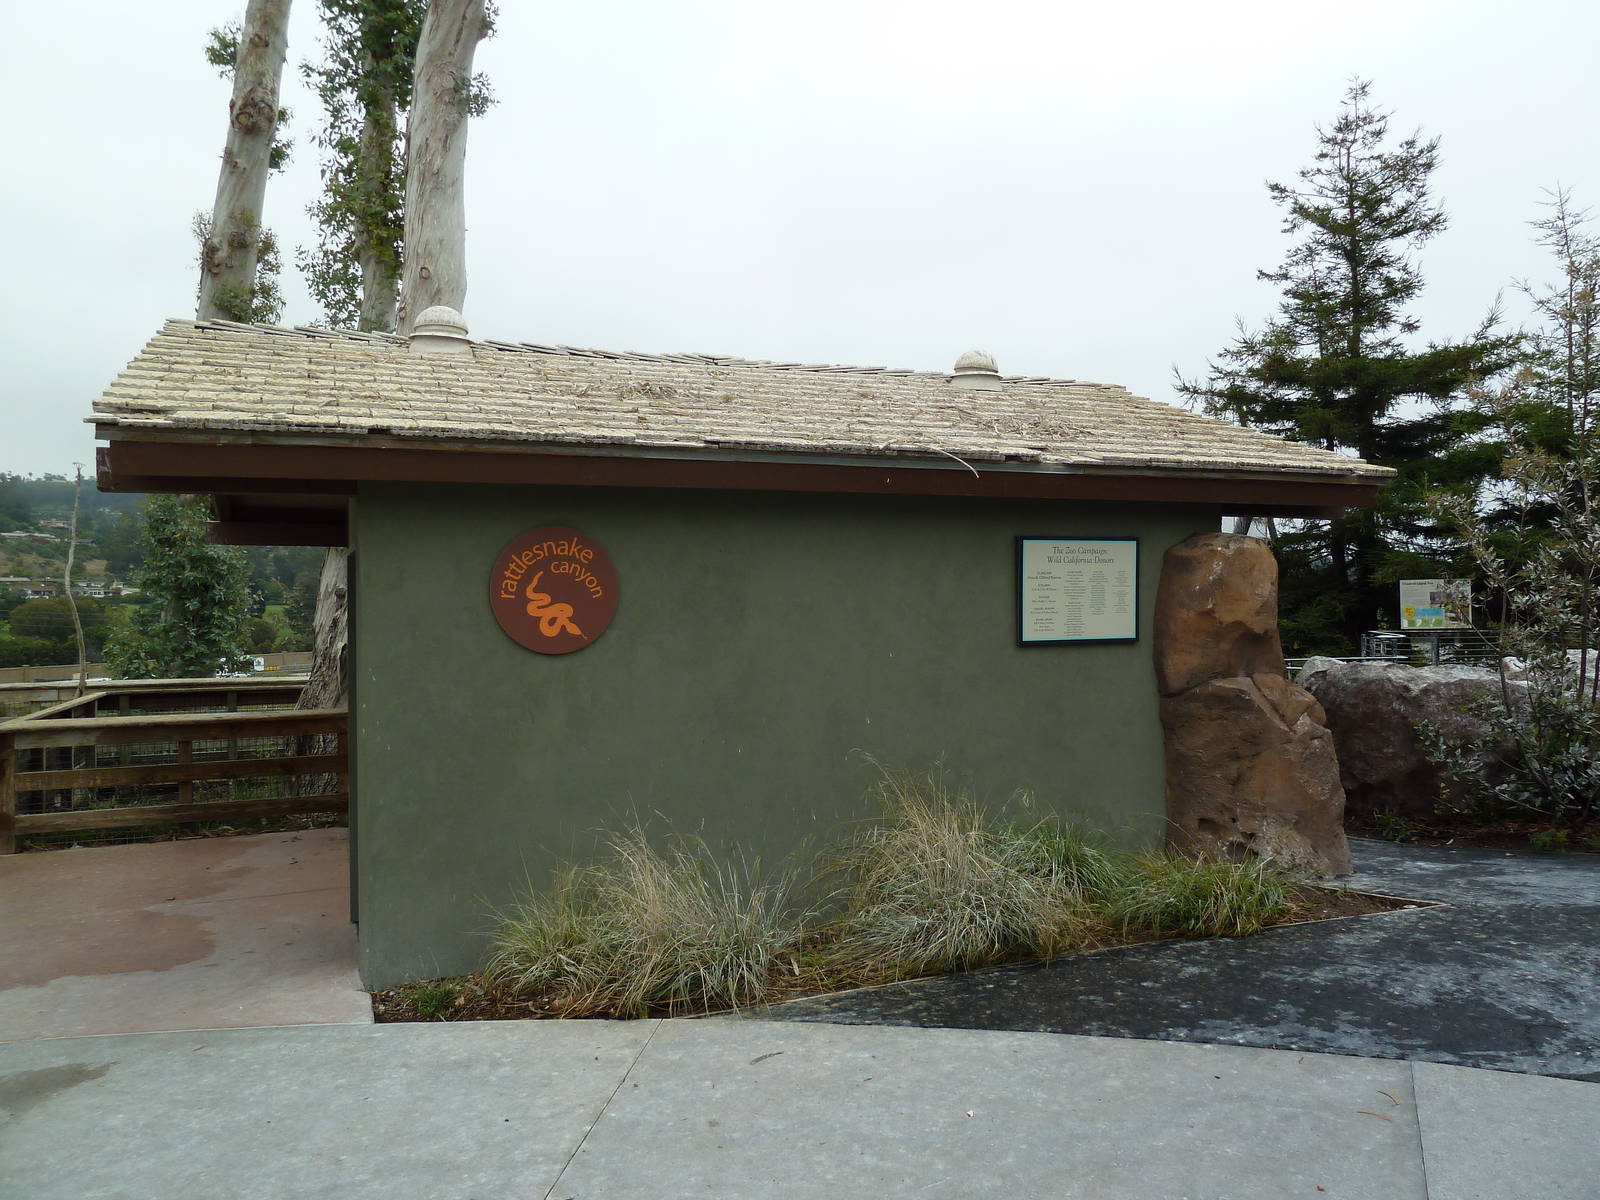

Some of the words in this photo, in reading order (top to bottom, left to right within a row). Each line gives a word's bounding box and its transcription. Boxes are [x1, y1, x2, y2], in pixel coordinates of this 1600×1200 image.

[1047, 556, 1062, 564] Wild
[1063, 555, 1093, 565] California
[1094, 556, 1114, 564] Donors
[1052, 546, 1064, 555] The
[1065, 546, 1077, 555] Zoo
[500, 537, 593, 599] rattlesnake
[551, 561, 603, 599] canyon
